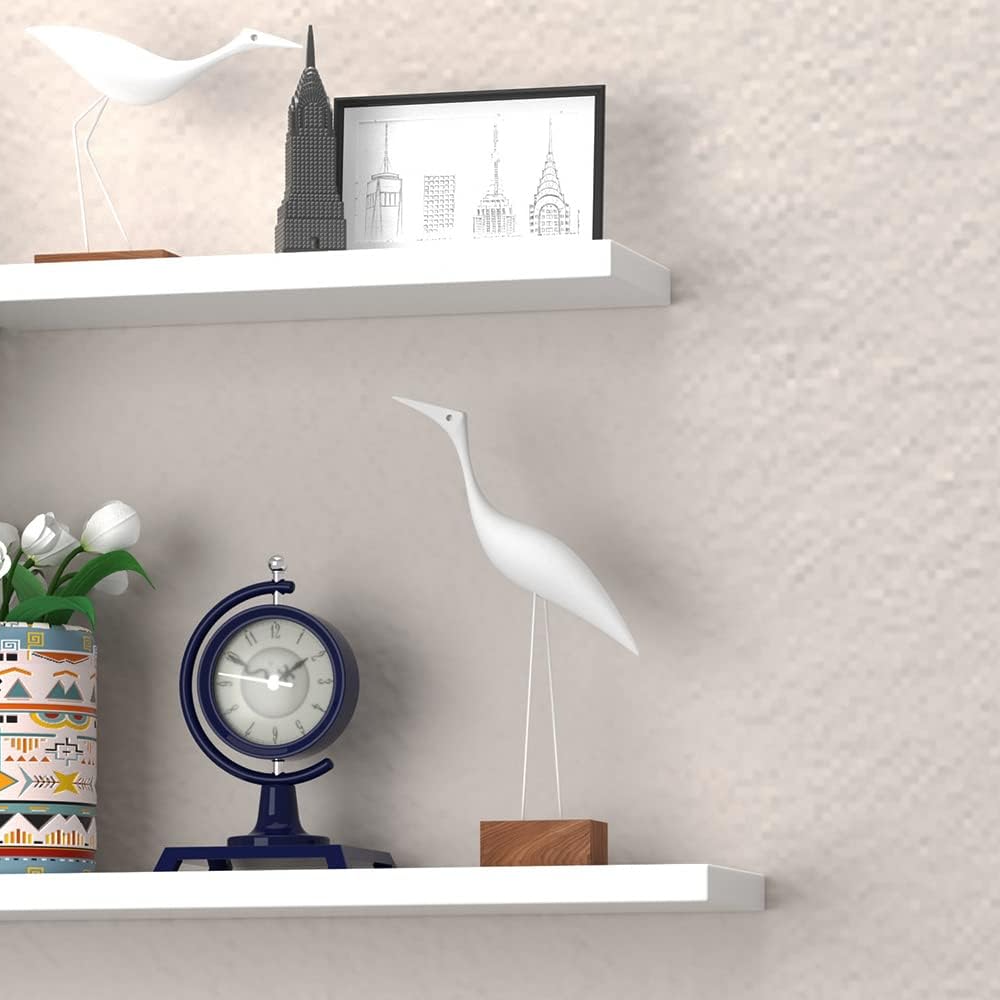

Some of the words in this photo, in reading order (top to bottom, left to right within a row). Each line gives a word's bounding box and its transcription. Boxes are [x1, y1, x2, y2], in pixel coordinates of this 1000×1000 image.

[244, 630, 258, 647] 11
[271, 622, 281, 639] 12
[296, 630, 305, 645] 1
[310, 649, 326, 662] 2
[311, 703, 326, 713] 4
[272, 726, 278, 744] 6
